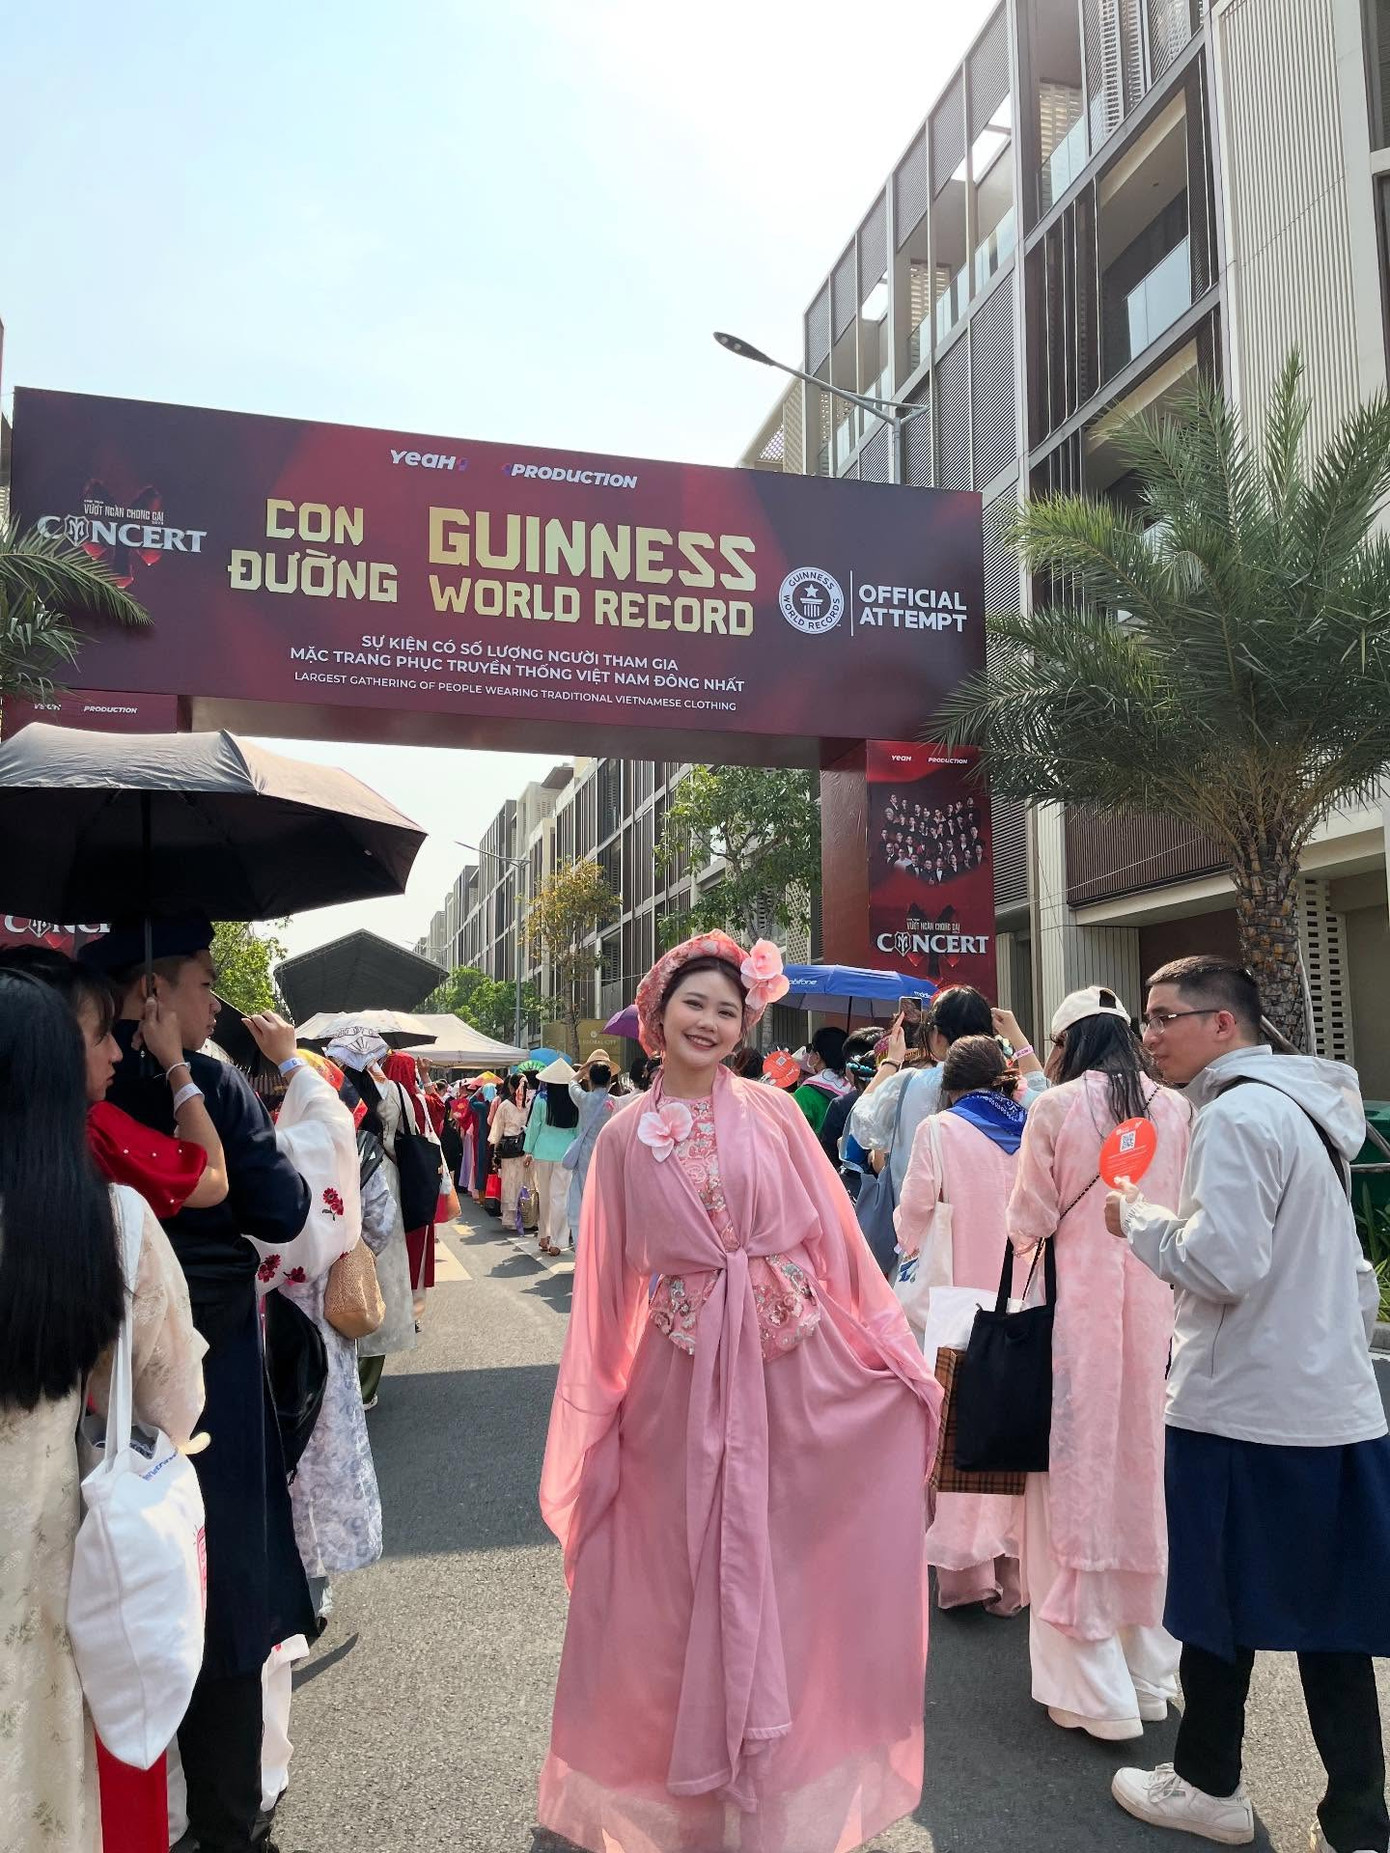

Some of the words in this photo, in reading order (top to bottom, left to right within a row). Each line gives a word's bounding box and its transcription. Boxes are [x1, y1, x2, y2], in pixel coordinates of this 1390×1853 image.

[511, 463, 638, 489] PRODUCTION
[266, 498, 364, 546] CON
[428, 506, 757, 592] GUINNESS
[227, 548, 398, 603] ĐƯỜNG
[788, 571, 835, 590] GUINNESS
[429, 574, 580, 623] WORLD
[595, 589, 754, 637] RECORD
[783, 594, 805, 626] WORLD
[808, 598, 840, 630] RECORDS
[858, 584, 967, 611] OFFICIAL
[859, 607, 967, 632] ATTEMPT
[290, 645, 329, 664] MẶC
[333, 650, 391, 667] TRANG
[396, 655, 443, 673] PHỤC
[447, 658, 511, 676] TRUYỀN
[516, 663, 572, 680] THỐNG
[576, 668, 610, 686] VIỆT
[614, 672, 650, 686] NAM
[653, 674, 700, 689] ĐÔNG
[704, 677, 745, 692] NHẤT
[361, 635, 385, 651] SỰ
[389, 636, 428, 654] KIỆN
[432, 640, 456, 654] CÓ
[460, 641, 483, 656] SỐ
[487, 645, 543, 662] LƯỢNG
[548, 650, 599, 665] NGƯỜI
[603, 654, 648, 669] THAM
[652, 658, 679, 671] GIA
[294, 671, 347, 685] LARGEST
[349, 675, 417, 690] GATHERING
[419, 681, 436, 690] OF
[438, 682, 483, 694] PEOPLE
[485, 685, 539, 698] WEARING
[541, 689, 613, 704] TRADITIONAL
[615, 695, 682, 708] VIETNAMESE
[684, 699, 737, 711] CLOTHING
[83, 705, 138, 714] PRODUCTION
